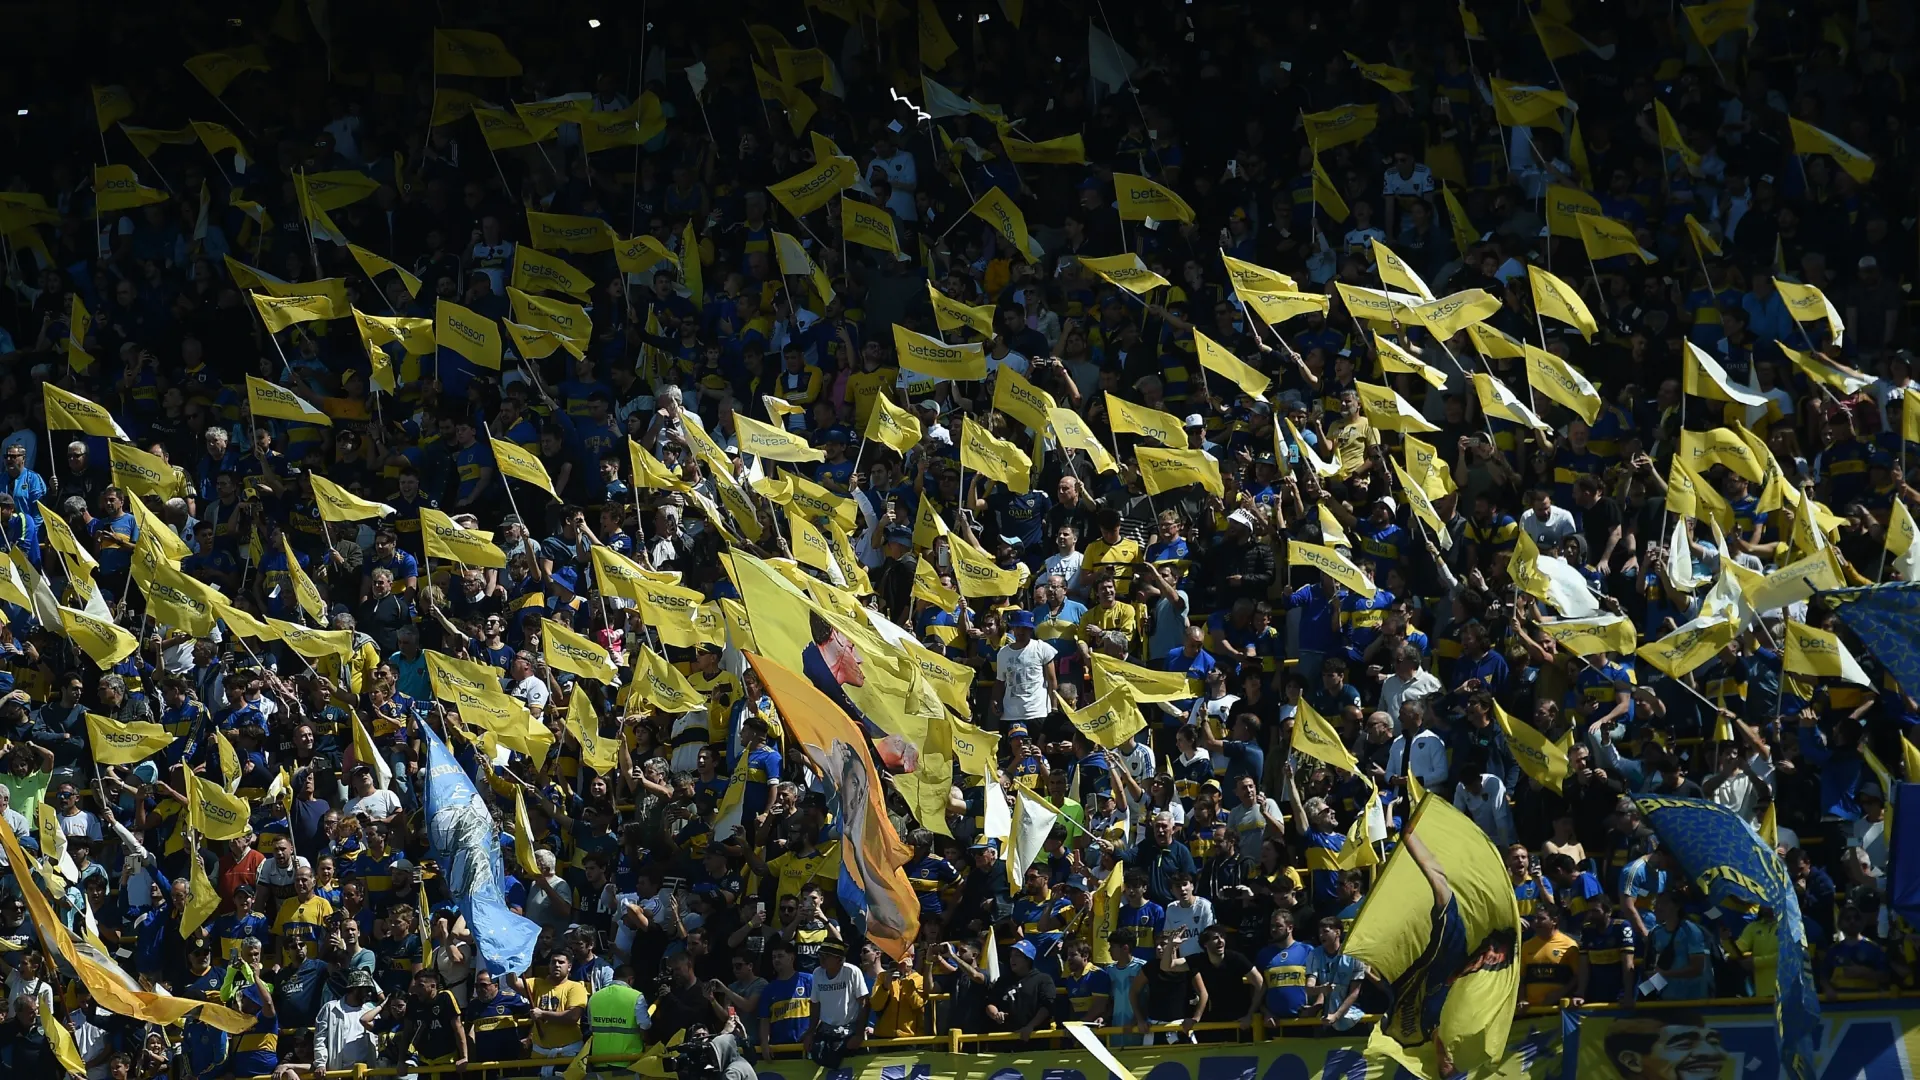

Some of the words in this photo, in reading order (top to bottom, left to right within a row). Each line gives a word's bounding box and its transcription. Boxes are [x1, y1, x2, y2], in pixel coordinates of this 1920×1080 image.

[789, 164, 842, 199] betsson
[522, 262, 573, 289] betsson
[449, 316, 486, 344] betsson
[908, 343, 962, 358] betsson
[1299, 546, 1355, 577] betsson
[151, 580, 206, 613] betsson
[648, 592, 691, 608] betsso
[552, 638, 604, 665] betsson
